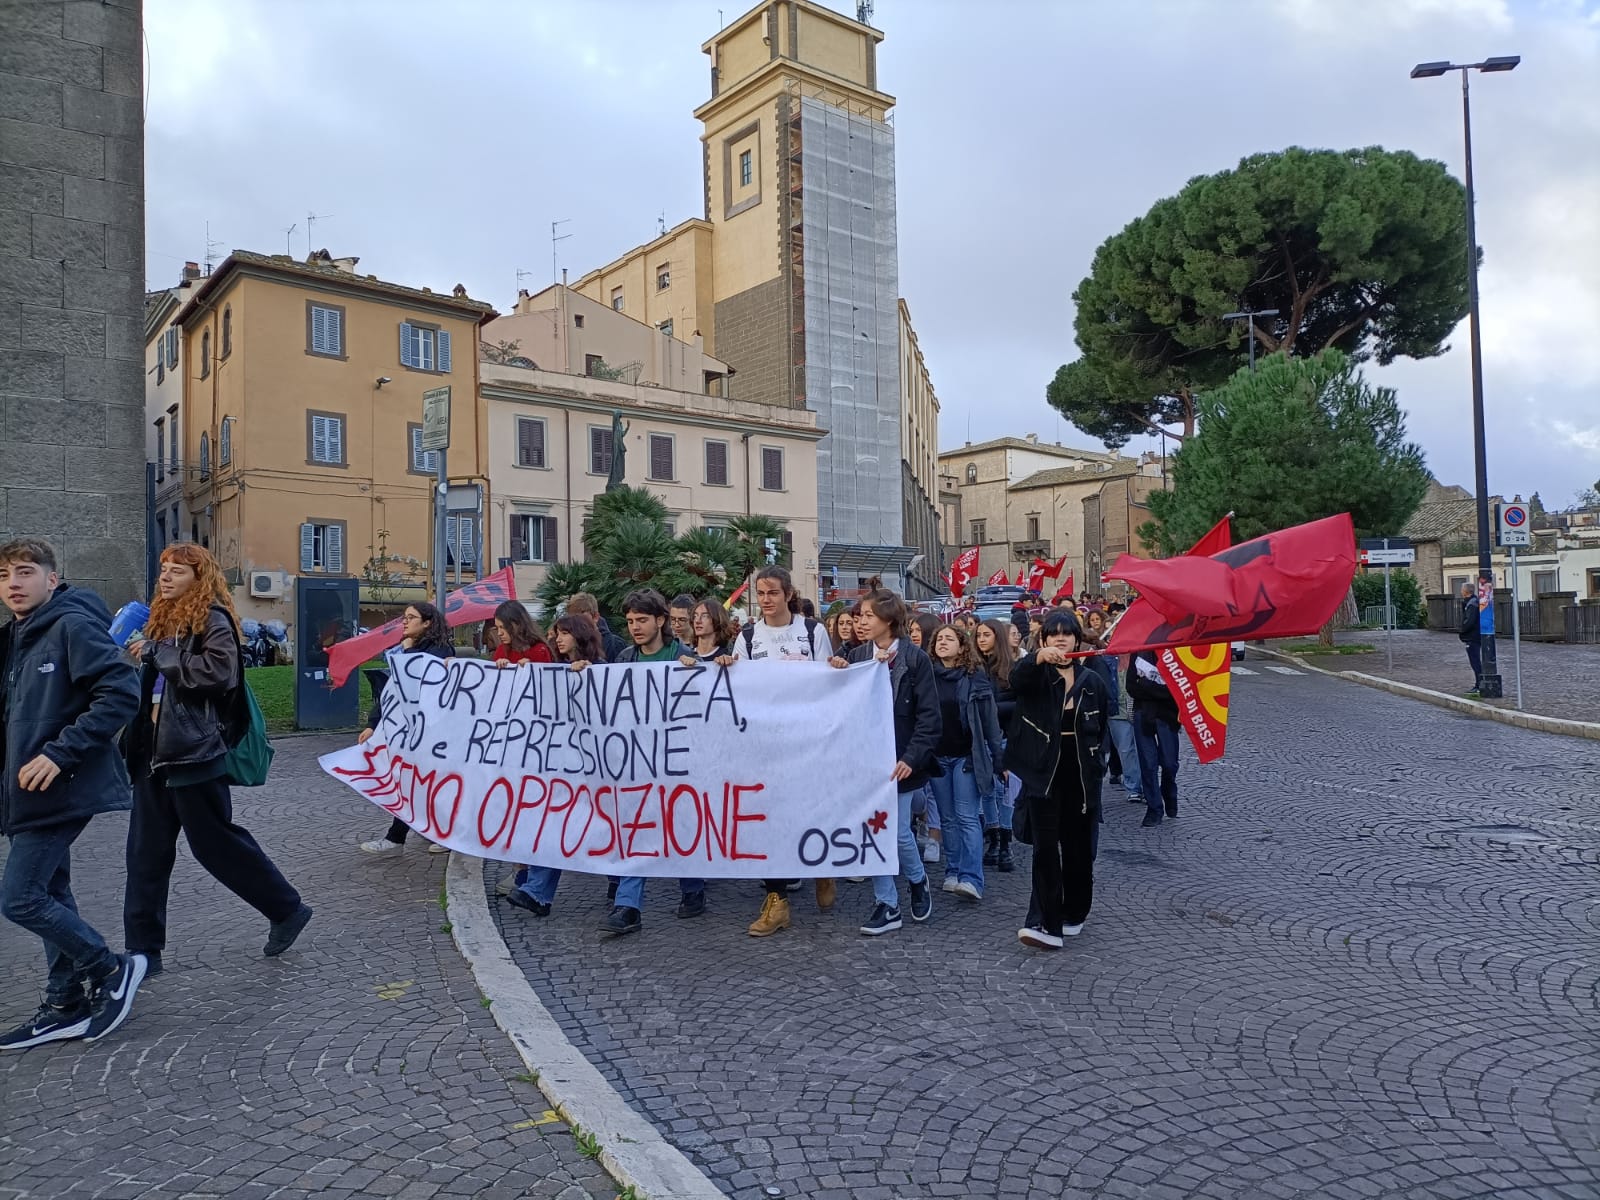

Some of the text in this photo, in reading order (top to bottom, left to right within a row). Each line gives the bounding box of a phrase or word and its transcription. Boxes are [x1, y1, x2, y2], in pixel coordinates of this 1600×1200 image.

[1186, 698, 1199, 714] DI
[431, 741, 448, 759] e
[465, 718, 690, 781] REPRESSIONE
[1191, 713, 1217, 749] BASE
[477, 774, 768, 862] OPPOSIZIONE
